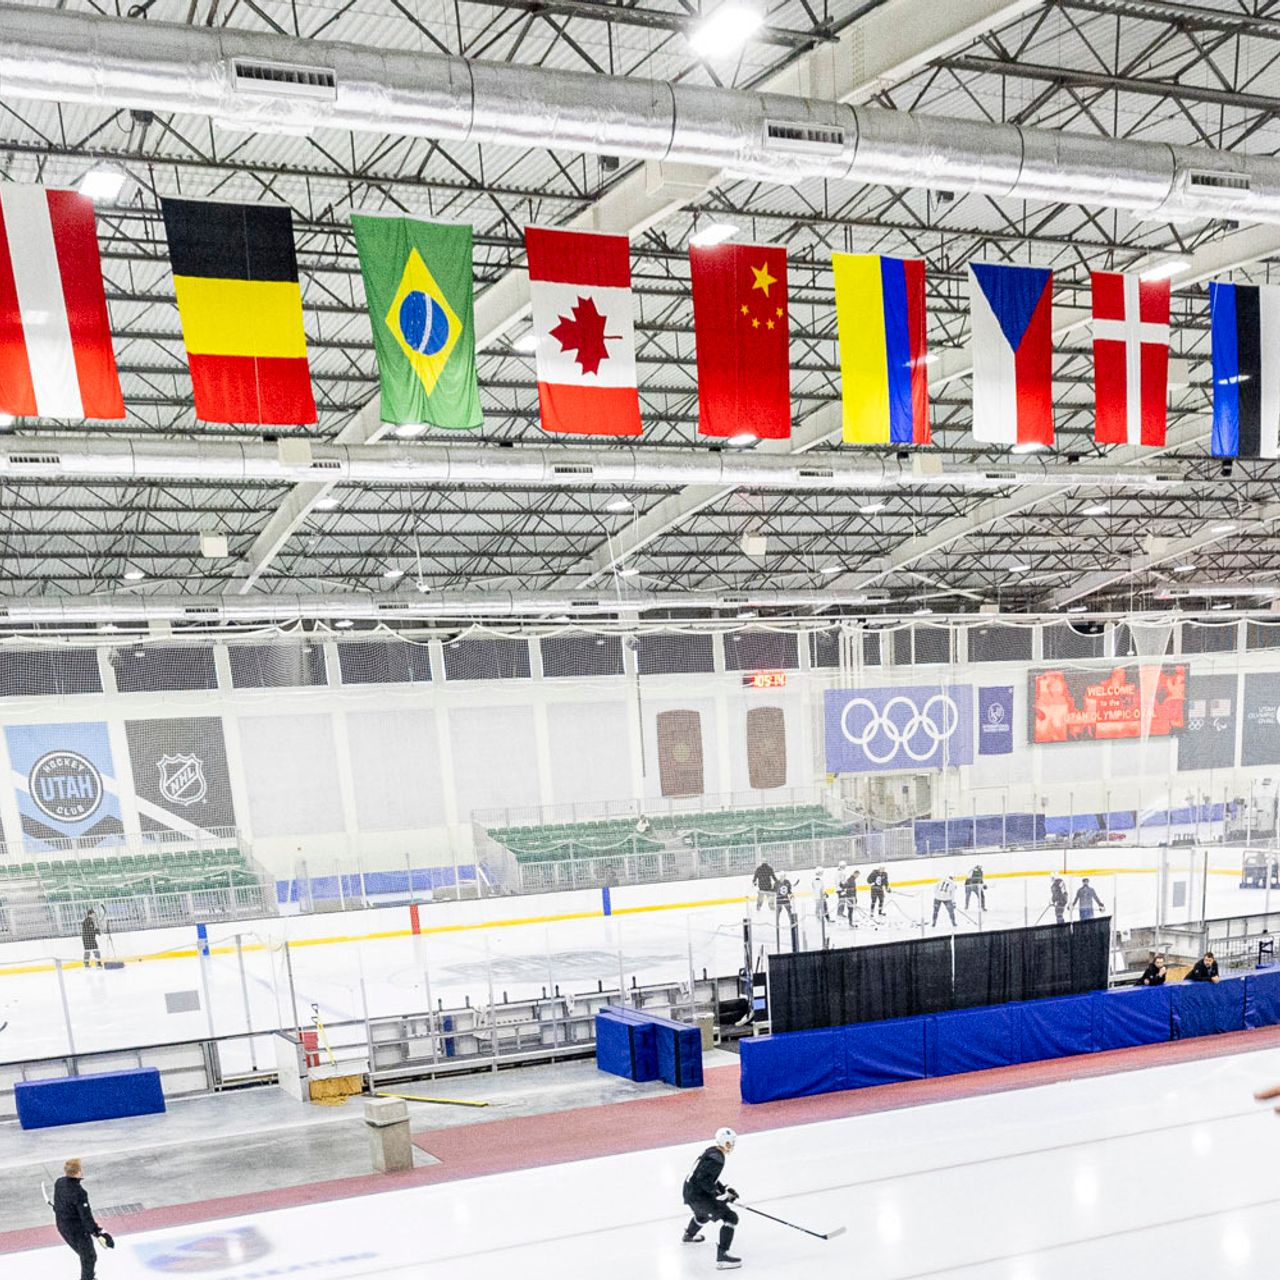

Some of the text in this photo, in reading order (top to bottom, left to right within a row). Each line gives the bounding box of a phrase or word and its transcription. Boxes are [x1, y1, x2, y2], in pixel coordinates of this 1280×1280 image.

[1087, 685, 1135, 697] WELCOME
[1109, 697, 1120, 707] the
[1091, 709, 1132, 721] OLYMPIC
[42, 758, 86, 774] HOCKEY
[169, 764, 197, 796] NHL
[39, 774, 95, 802] UTAH
[56, 804, 86, 815] CLUB
